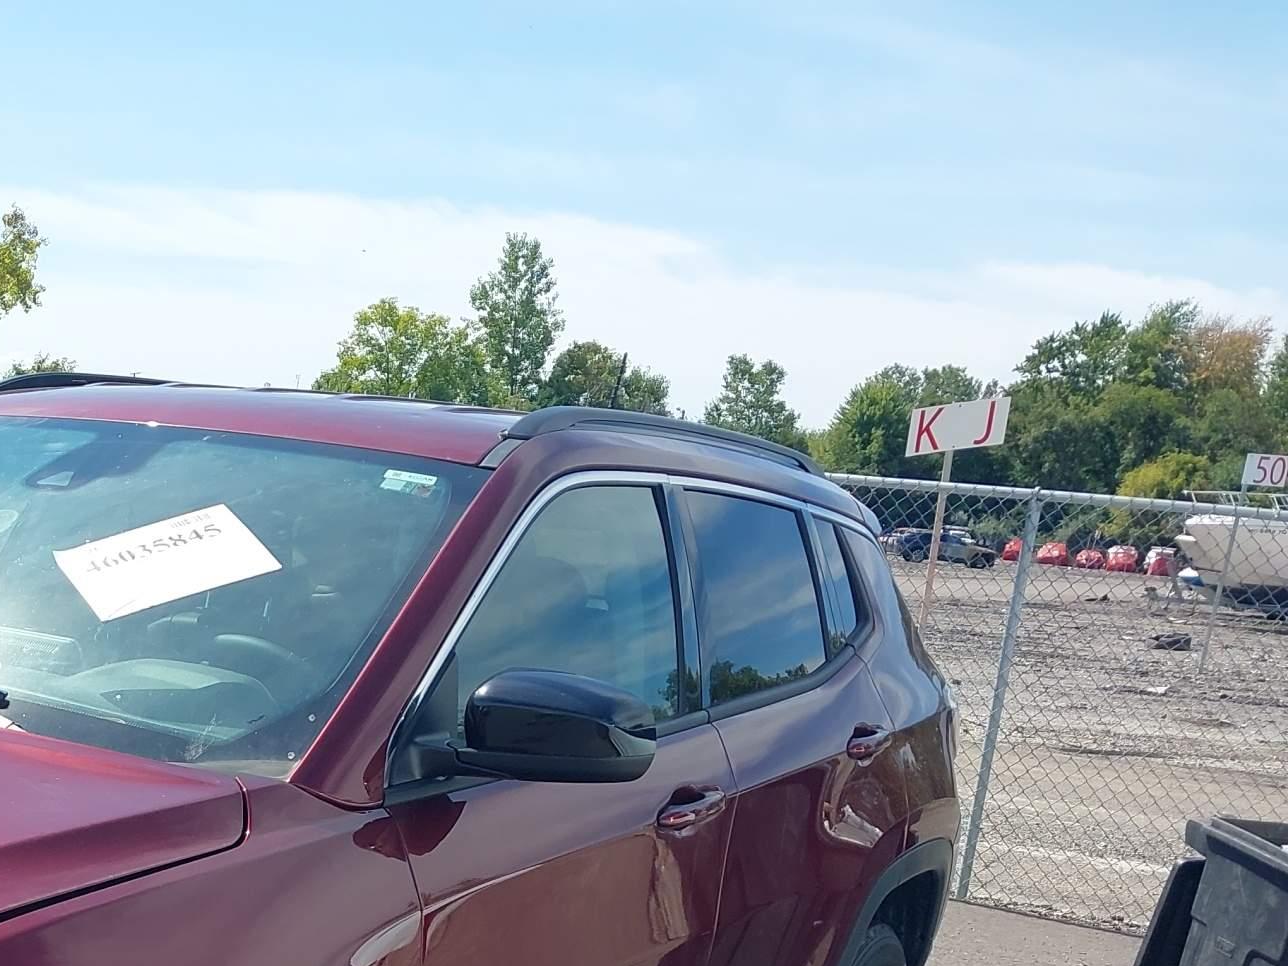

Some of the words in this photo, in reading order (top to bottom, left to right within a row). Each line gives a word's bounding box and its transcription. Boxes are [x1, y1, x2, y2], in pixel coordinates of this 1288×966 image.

[914, 406, 945, 453] K
[972, 400, 996, 445] J
[1253, 455, 1286, 485] 50
[86, 523, 223, 574] 46035845
